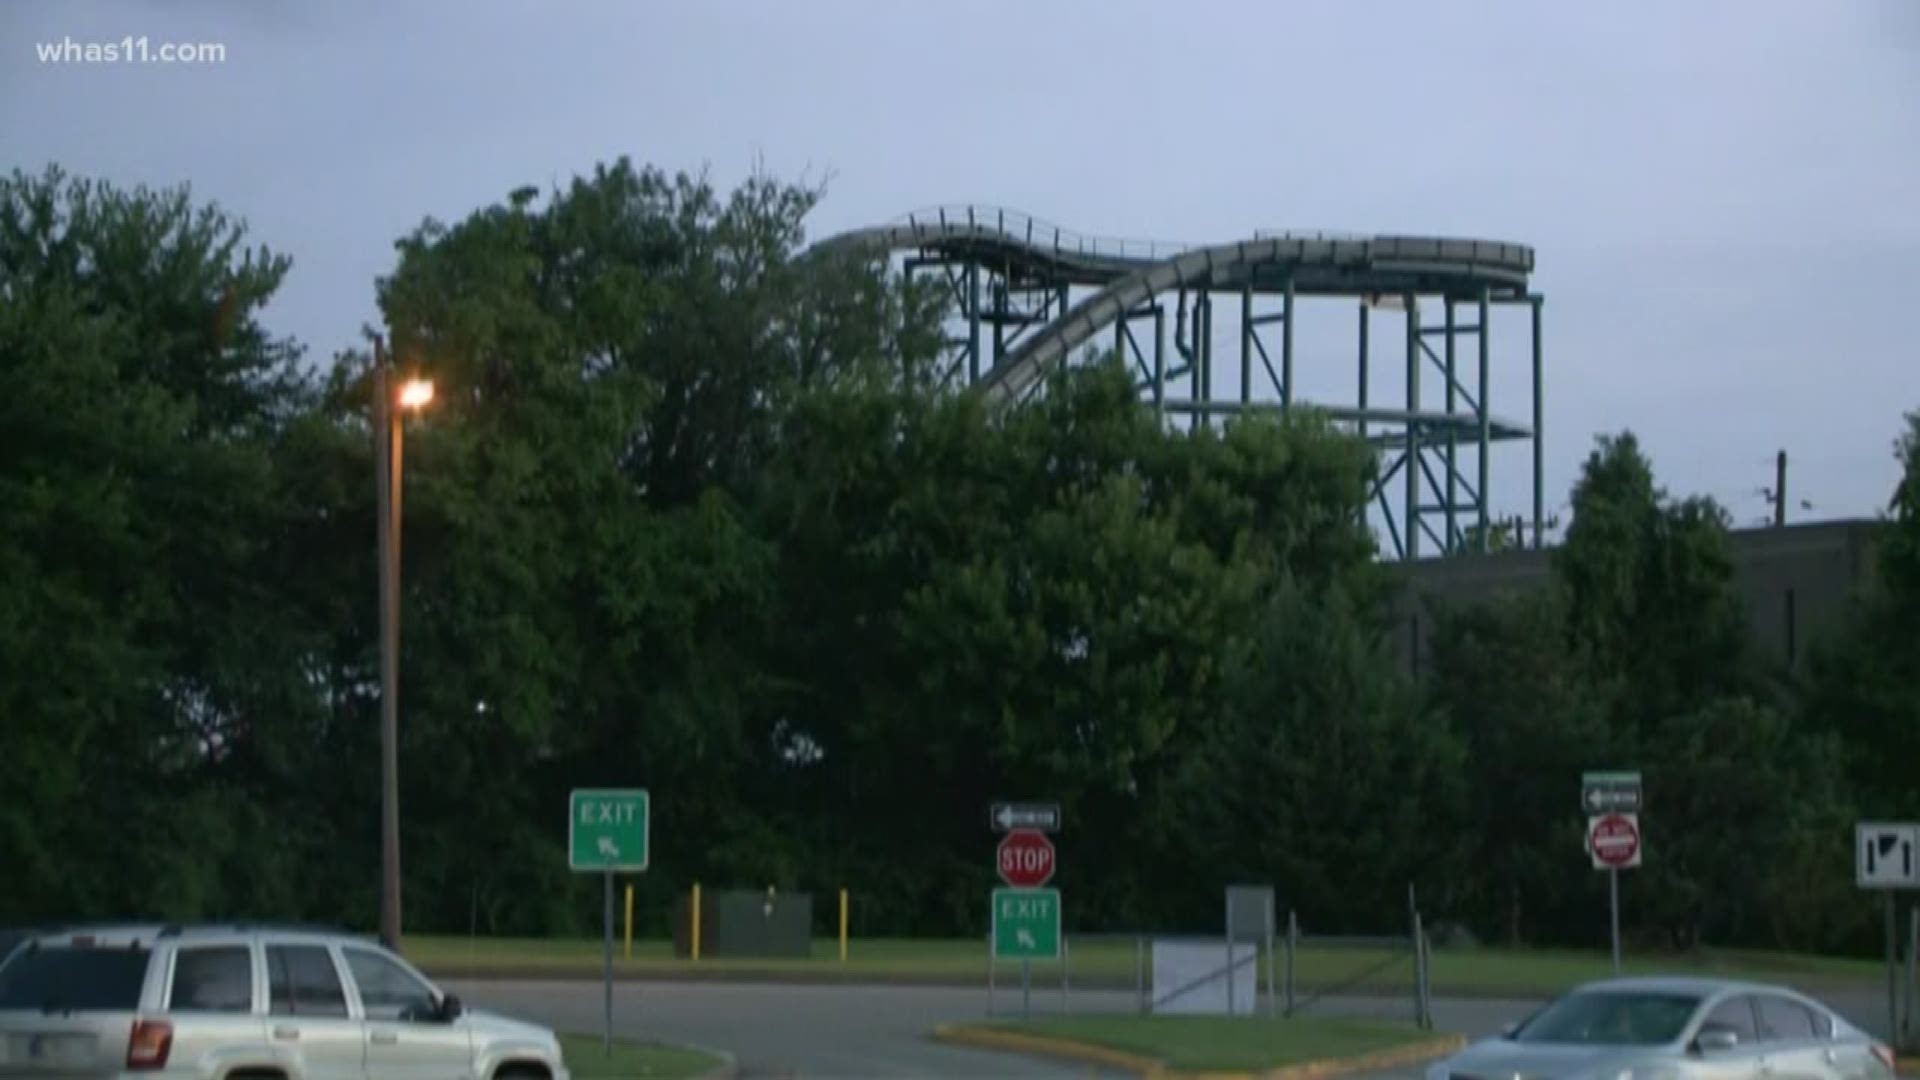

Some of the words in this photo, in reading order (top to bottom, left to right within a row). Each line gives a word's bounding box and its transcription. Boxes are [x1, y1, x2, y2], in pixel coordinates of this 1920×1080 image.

[581, 801, 637, 825] EXIT
[1002, 847, 1051, 872] STOP
[1002, 898, 1050, 919] EXIT
